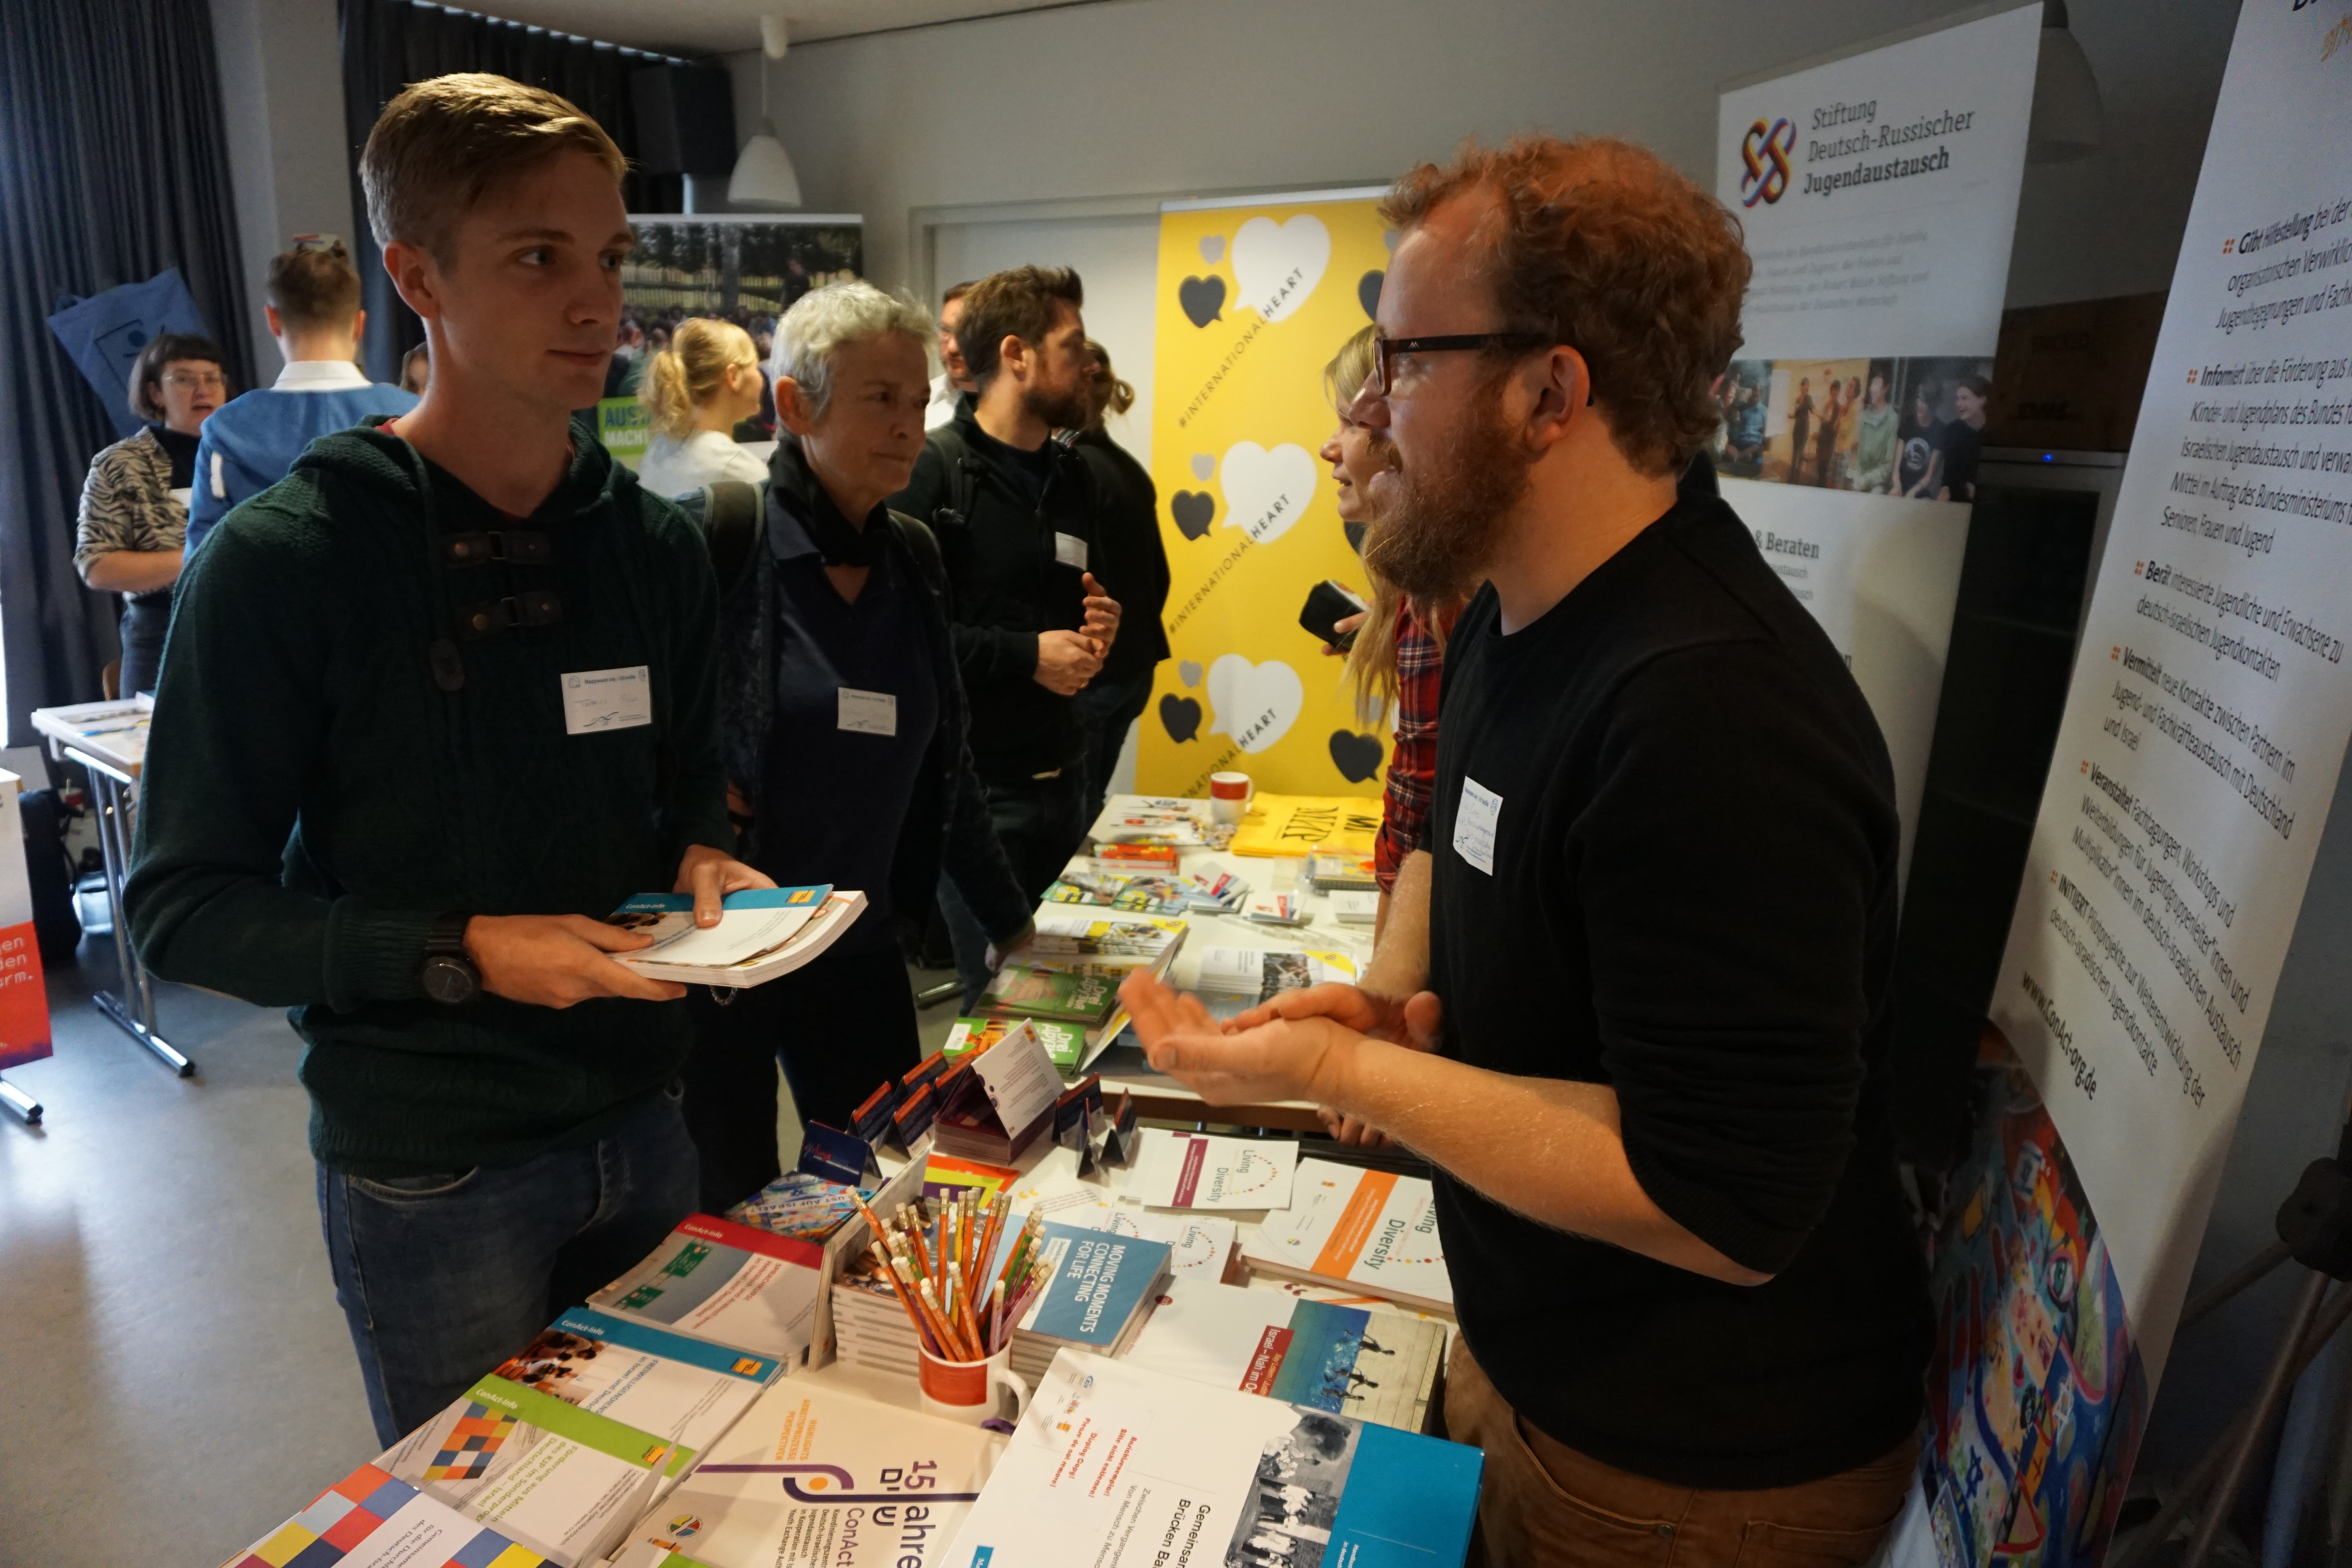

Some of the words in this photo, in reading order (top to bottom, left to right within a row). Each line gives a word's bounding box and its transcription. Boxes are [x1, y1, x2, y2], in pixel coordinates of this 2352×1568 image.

[1812, 99, 1877, 130] Stiftung
[1808, 109, 1975, 162] Deutsch-Russischer
[1804, 146, 1949, 196] Jugendaustausch
[2239, 229, 2263, 254] Gibt
[2304, 284, 2327, 313] und
[1177, 267, 1304, 429] #INTERNATIONALHEART
[2200, 363, 2245, 386] Informiert
[2279, 356, 2329, 389] Förderung
[2328, 357, 2348, 379] aus
[2290, 398, 2308, 424] des
[2307, 396, 2346, 425] Bundes
[2226, 439, 2300, 470] Jugendaustausch
[2299, 442, 2321, 470] und
[2209, 476, 2239, 510] Auftrag
[2238, 480, 2257, 506] des
[2254, 483, 2347, 523] Bundesministeriums
[1766, 532, 1820, 559] Beraten
[2198, 514, 2224, 541] Frauen
[2225, 521, 2245, 545] und
[2241, 524, 2276, 558] Jugend
[1167, 492, 1290, 634] #INTERNATIONALHEART
[2145, 560, 2172, 586] Berät
[2212, 584, 2263, 624] Jugendliche
[2262, 605, 2285, 632] und
[2280, 610, 2332, 658] Erwachsene
[2329, 639, 2345, 664] zu
[2137, 593, 2211, 643] deutsch-israelischen
[2209, 626, 2281, 682] Jugendkontakten
[2123, 646, 2162, 685] Vermittelt
[2160, 671, 2178, 696] neue
[2178, 679, 2214, 719] Kontakte
[2213, 705, 2250, 744] zwischen
[2248, 724, 2283, 773] Partnern
[2281, 750, 2296, 784] im
[2103, 716, 2123, 737] und
[2120, 722, 2142, 751] Israel
[2112, 680, 2143, 711] Jugend-
[2142, 701, 2160, 724] und
[2156, 706, 2232, 781] Fachkräfteaustausch
[2230, 767, 2246, 793] mit
[2244, 773, 2296, 840] Deutschland
[2091, 762, 2134, 814] Veranstaltet
[2131, 798, 2181, 867] Fachtagungen,
[2182, 846, 2220, 910] Workshops
[2217, 897, 2237, 929] und
[2082, 793, 2134, 861] Weiterbildungen
[2134, 844, 2147, 871] für
[2231, 978, 2252, 1015] und
[2050, 906, 2111, 997] deutsch-israelischen
[2108, 984, 2158, 1076] Jugendkontakte
[2058, 874, 2091, 920] INITIIERT
[2087, 906, 2126, 972] Pilotprojekte
[2124, 962, 2138, 987] zur
[2136, 972, 2194, 1095] Weiterentwicklung
[2190, 1072, 2205, 1109] der
[2133, 890, 2145, 917] im
[2143, 902, 2208, 1010] deutsch-israelischen
[2205, 994, 2242, 1072] Austausch
[1056, 1033, 1073, 1053] Drei
[2022, 971, 2097, 1100] www.ConAct-org.de
[1236, 1150, 1255, 1173] Living
[1207, 1167, 1230, 1202] Diversity
[800, 1198, 820, 1207] AUF
[684, 1224, 722, 1238] ConAct-Info
[1106, 1212, 1125, 1234] Living
[1076, 1240, 1094, 1258] FOR
[1181, 1226, 1201, 1249] Living
[1364, 1219, 1406, 1270] Diversity
[742, 1265, 757, 1280] Israel
[1067, 1258, 1085, 1279] LIFE
[1074, 1242, 1110, 1303] CONNECTING
[1100, 1244, 1126, 1283] MOVING
[743, 1263, 782, 1301] SPRACHKURSE
[695, 1290, 732, 1318] Deutschland
[1080, 1283, 1111, 1333] MOMENTS
[561, 1319, 604, 1336] ConAct-Info
[1263, 1329, 1281, 1349] Israel
[621, 1362, 642, 1379] Israel
[638, 1355, 648, 1364] in
[1254, 1355, 1270, 1370] Nah
[1267, 1363, 1279, 1378] Lotem
[608, 1377, 624, 1390] und
[1249, 1371, 1263, 1381] im
[1259, 1381, 1271, 1396] Judith
[475, 1388, 519, 1409] ConAct-Info
[774, 1410, 796, 1461] PERSPEKTIVEN
[787, 1399, 811, 1461] ARBEITSPROZESSE
[799, 1419, 817, 1461] HIGHLIGHTS
[1076, 1417, 1091, 1439] Please
[1115, 1428, 1128, 1444] Bitte
[551, 1441, 566, 1455] des
[1064, 1449, 1073, 1460] not
[1071, 1439, 1079, 1448] do
[1079, 1432, 1098, 1457] Display
[1106, 1445, 1118, 1462] nicht
[507, 1437, 557, 1481] Deutschland
[526, 1468, 538, 1478] im
[535, 1445, 578, 1483] Förderung
[539, 1455, 554, 1469] KJP
[1069, 1458, 1084, 1479] Copy!
[1103, 1436, 1137, 1497] Ansichtsexemplar!
[904, 1460, 937, 1490] 15
[1049, 1461, 1067, 1488] remove!
[1088, 1463, 1109, 1498] entfernen!
[477, 1486, 503, 1508] Israel
[522, 1482, 537, 1496] aus
[1126, 1484, 1138, 1499] Von
[491, 1495, 524, 1523] Mitteln
[786, 1509, 797, 1526] Youth
[1112, 1500, 1131, 1530] Mensch
[1129, 1487, 1151, 1524] Zwischen
[412, 1519, 425, 1531] des
[423, 1524, 435, 1534] für
[791, 1515, 807, 1551] Kooperation
[800, 1508, 819, 1559] Jugendaustausch
[835, 1507, 865, 1567] ConAct
[1107, 1530, 1116, 1541] zu
[1161, 1498, 1192, 1548] Brücken
[410, 1534, 423, 1544] die
[778, 1526, 793, 1555] Exchange
[788, 1552, 796, 1562] mit
